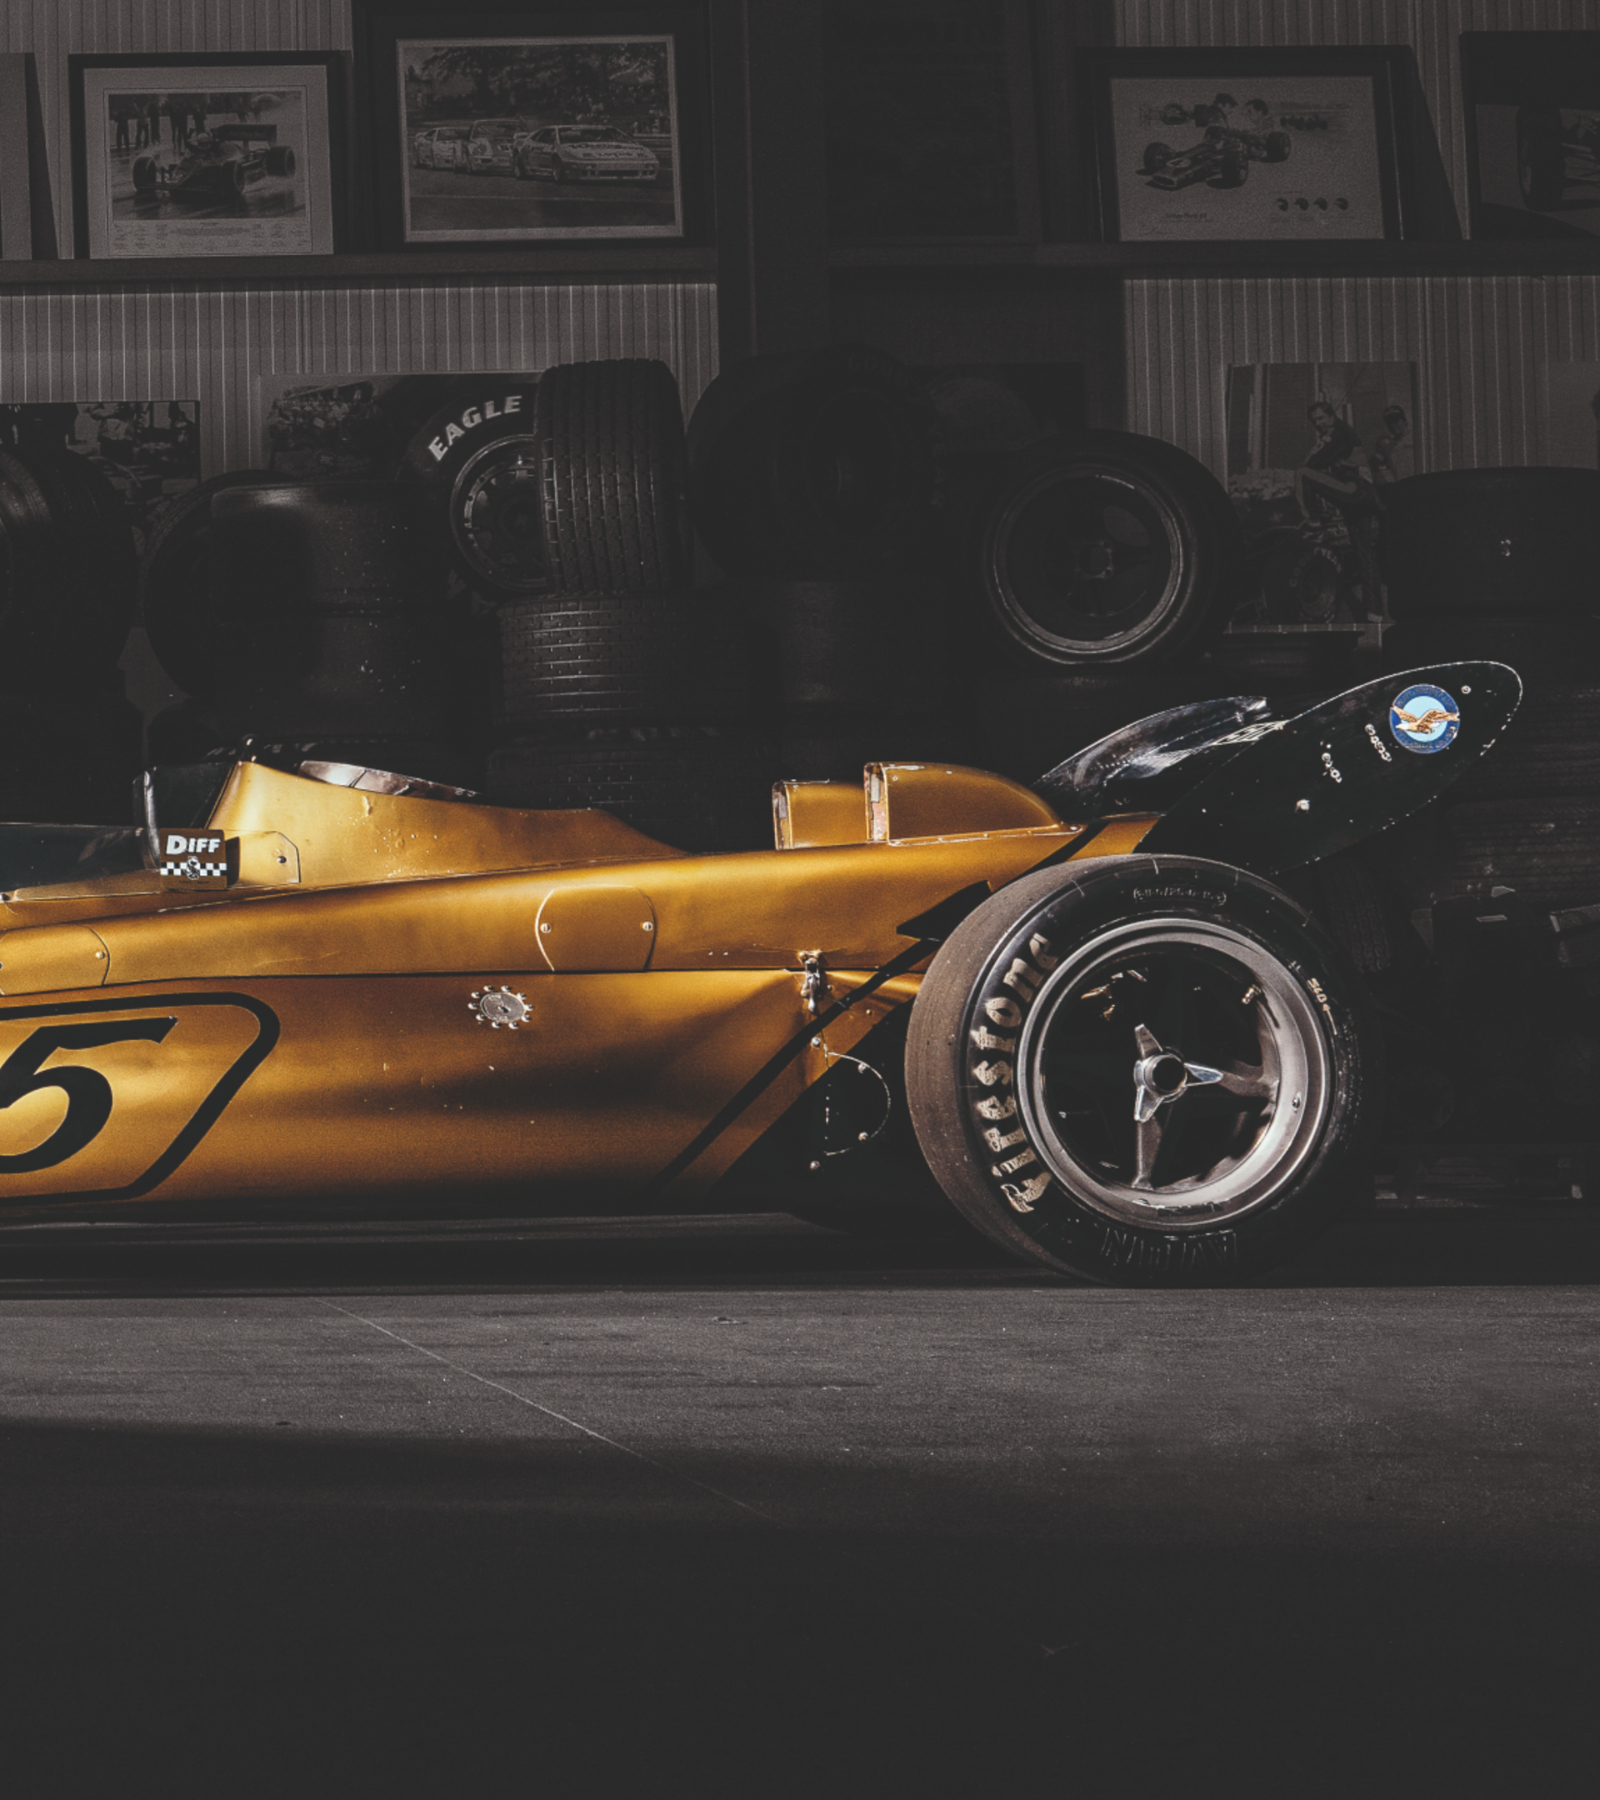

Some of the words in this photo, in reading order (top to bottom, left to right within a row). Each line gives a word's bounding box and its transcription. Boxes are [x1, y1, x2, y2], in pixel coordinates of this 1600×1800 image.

[427, 394, 523, 463] EAGLE
[970, 932, 1058, 1214] Firestone
[1099, 1227, 1238, 1272] AVON
